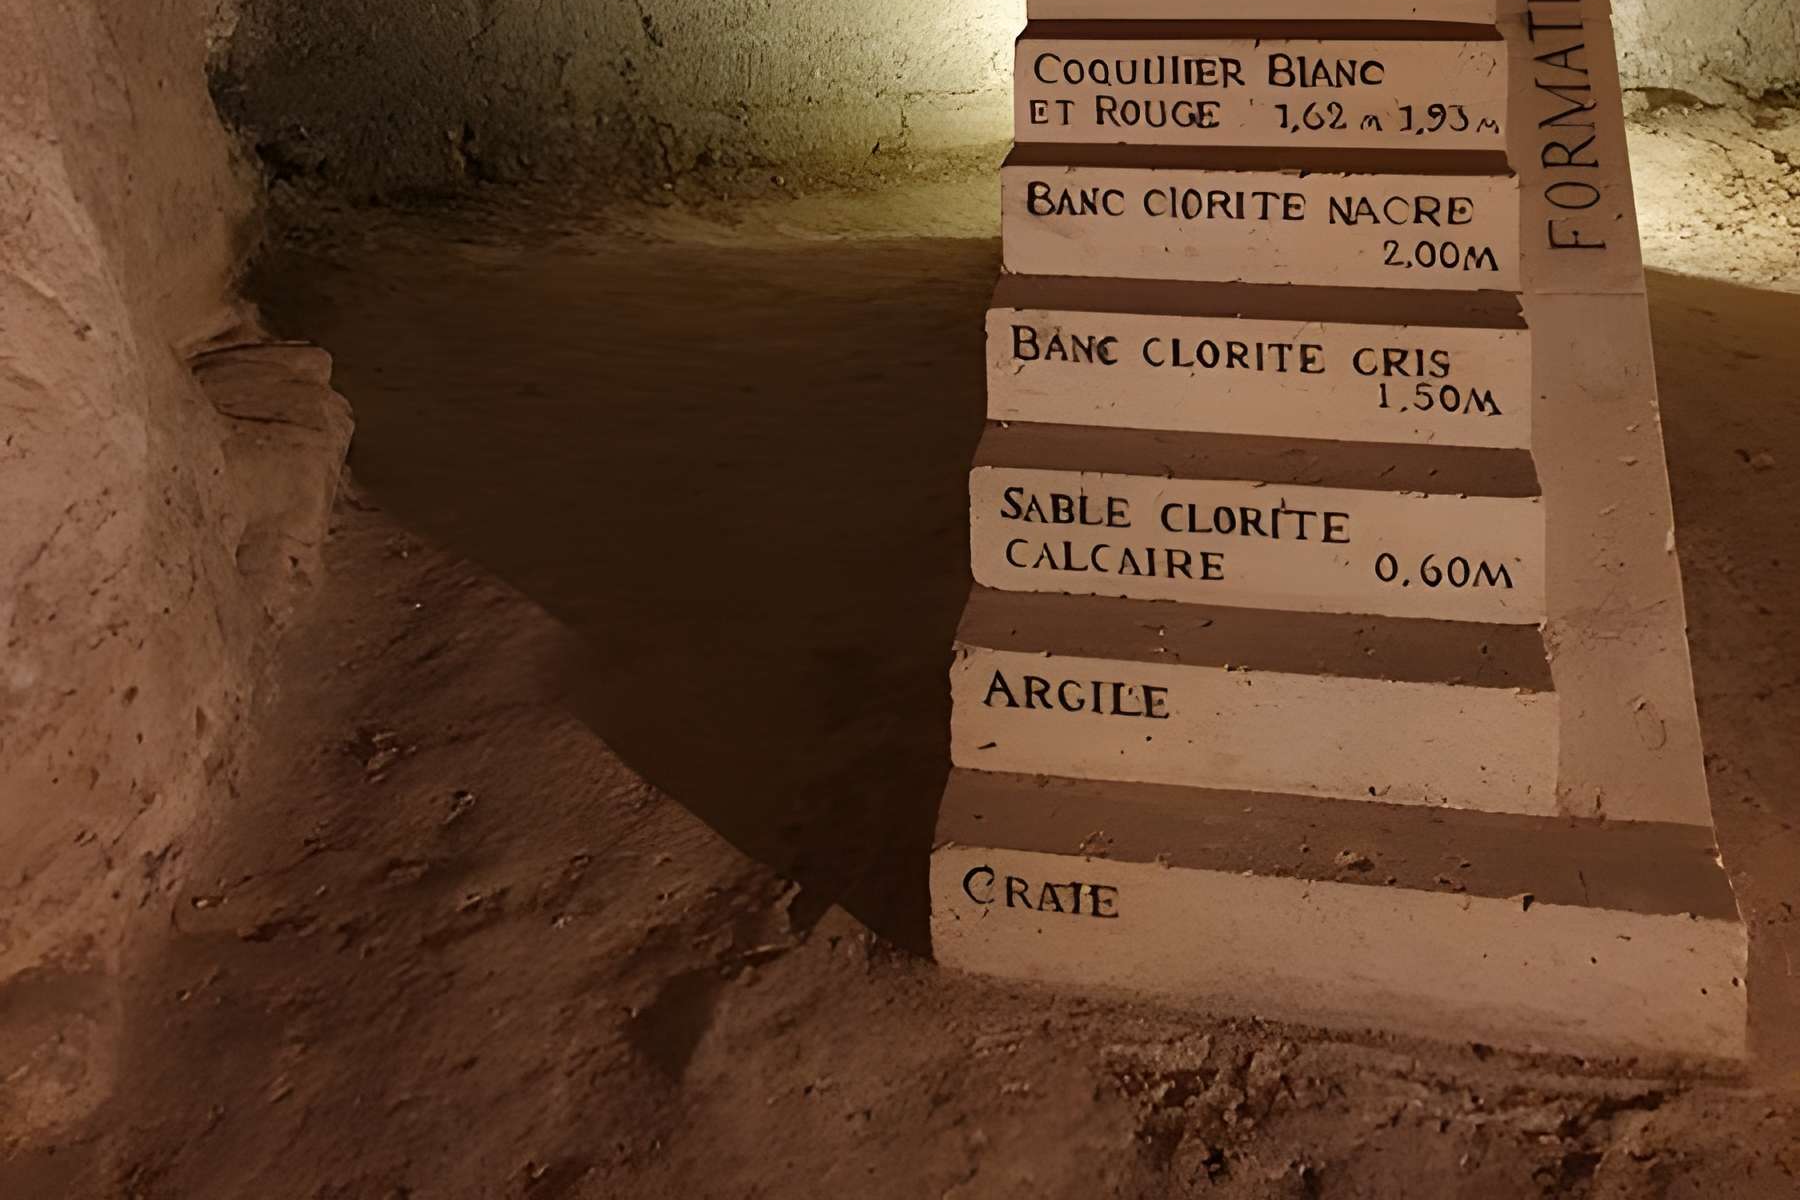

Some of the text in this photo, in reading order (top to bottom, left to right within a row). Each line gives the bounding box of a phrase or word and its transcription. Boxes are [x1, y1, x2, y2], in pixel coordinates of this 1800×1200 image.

[1029, 99, 1075, 125] ET
[1096, 95, 1221, 129] ROUGE
[1026, 180, 1126, 218] BANC
[1328, 195, 1474, 226] NACRE
[1011, 325, 1119, 367] BANC
[1142, 336, 1327, 375] CLORITE
[1000, 486, 1351, 544] SABLE CLORITE
[1005, 538, 1226, 581] CALCAIRE
[982, 670, 1171, 720] ARGILE
[962, 864, 1120, 919] CRAIE
